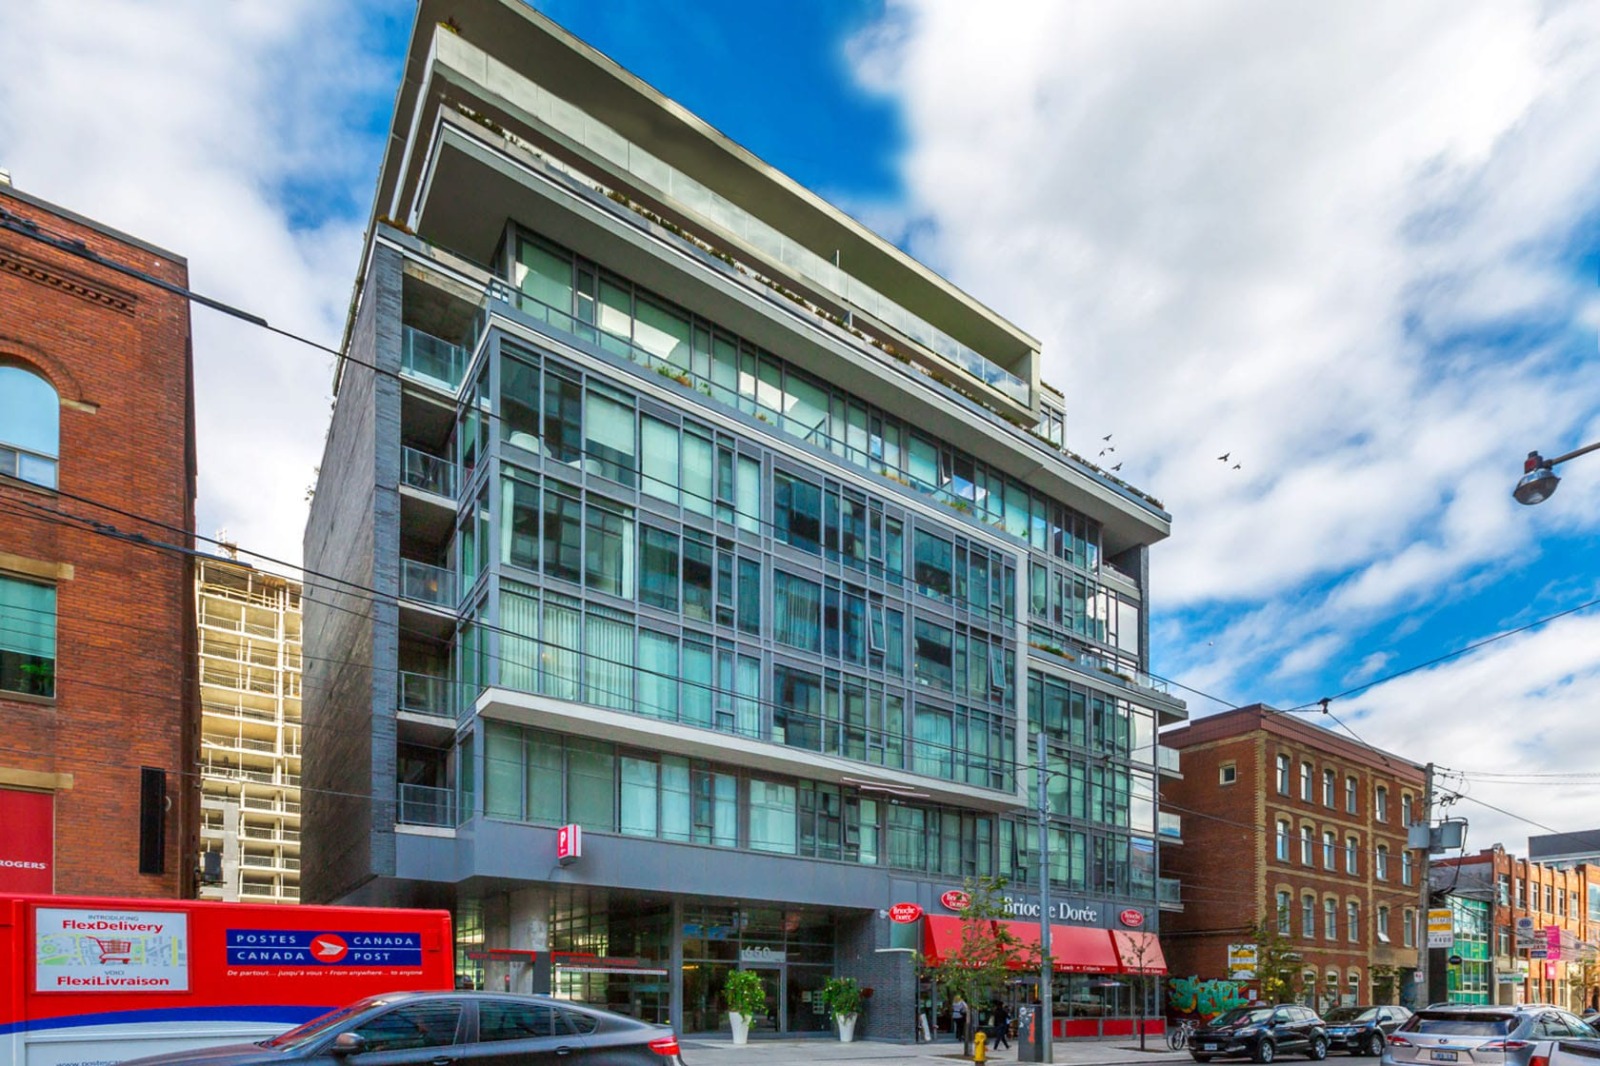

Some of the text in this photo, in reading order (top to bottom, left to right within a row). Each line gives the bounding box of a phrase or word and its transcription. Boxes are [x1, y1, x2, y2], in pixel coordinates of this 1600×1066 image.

[560, 831, 566, 848] P
[1003, 896, 1097, 922] Brioce Dorée
[62, 920, 163, 934] FlexDelivery
[236, 935, 297, 944] POSTES
[353, 937, 414, 945] CANADA
[237, 952, 306, 960] CANADA
[354, 953, 391, 961] POST
[744, 946, 770, 959] 650
[57, 976, 170, 986] FlexiLivraison
